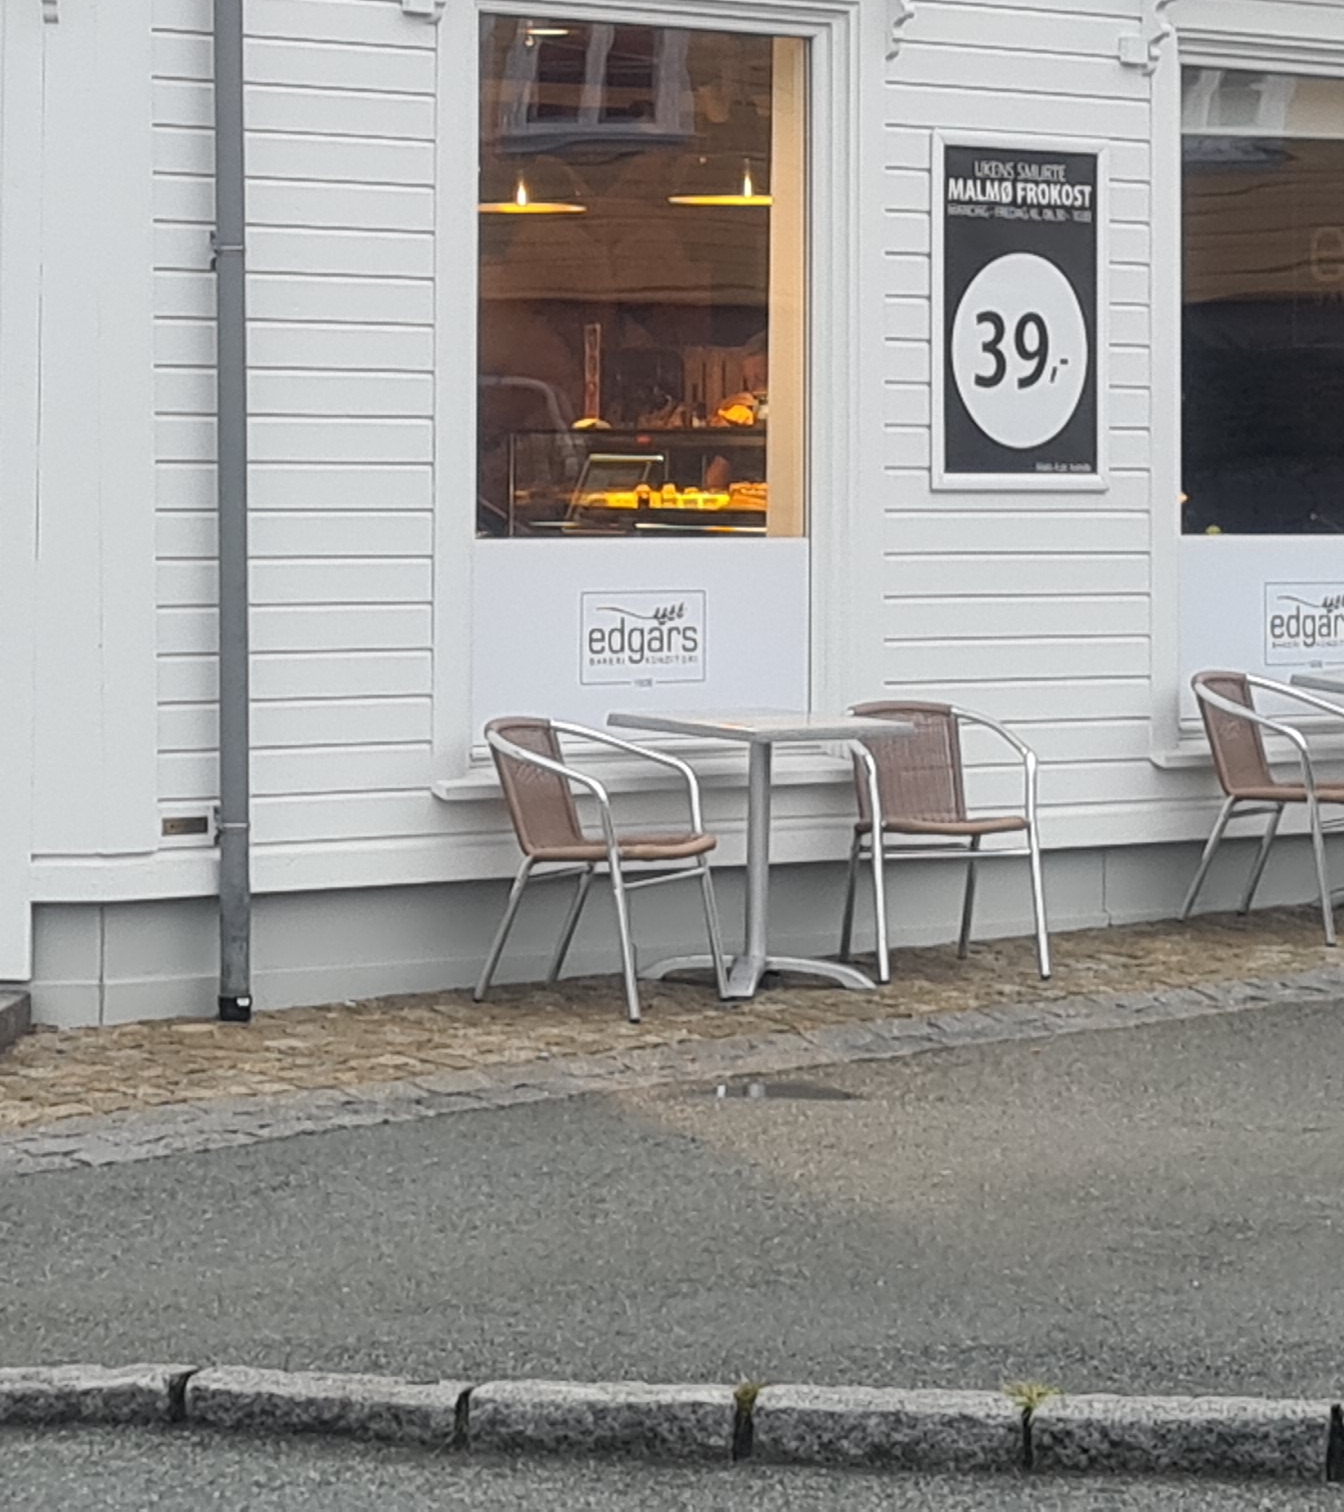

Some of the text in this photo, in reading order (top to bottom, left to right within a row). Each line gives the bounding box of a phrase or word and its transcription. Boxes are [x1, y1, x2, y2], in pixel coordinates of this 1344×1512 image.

[1016, 161, 1067, 182] SMURTE
[947, 177, 1093, 208] MALMØ FROKOST
[588, 616, 699, 665] edgars
